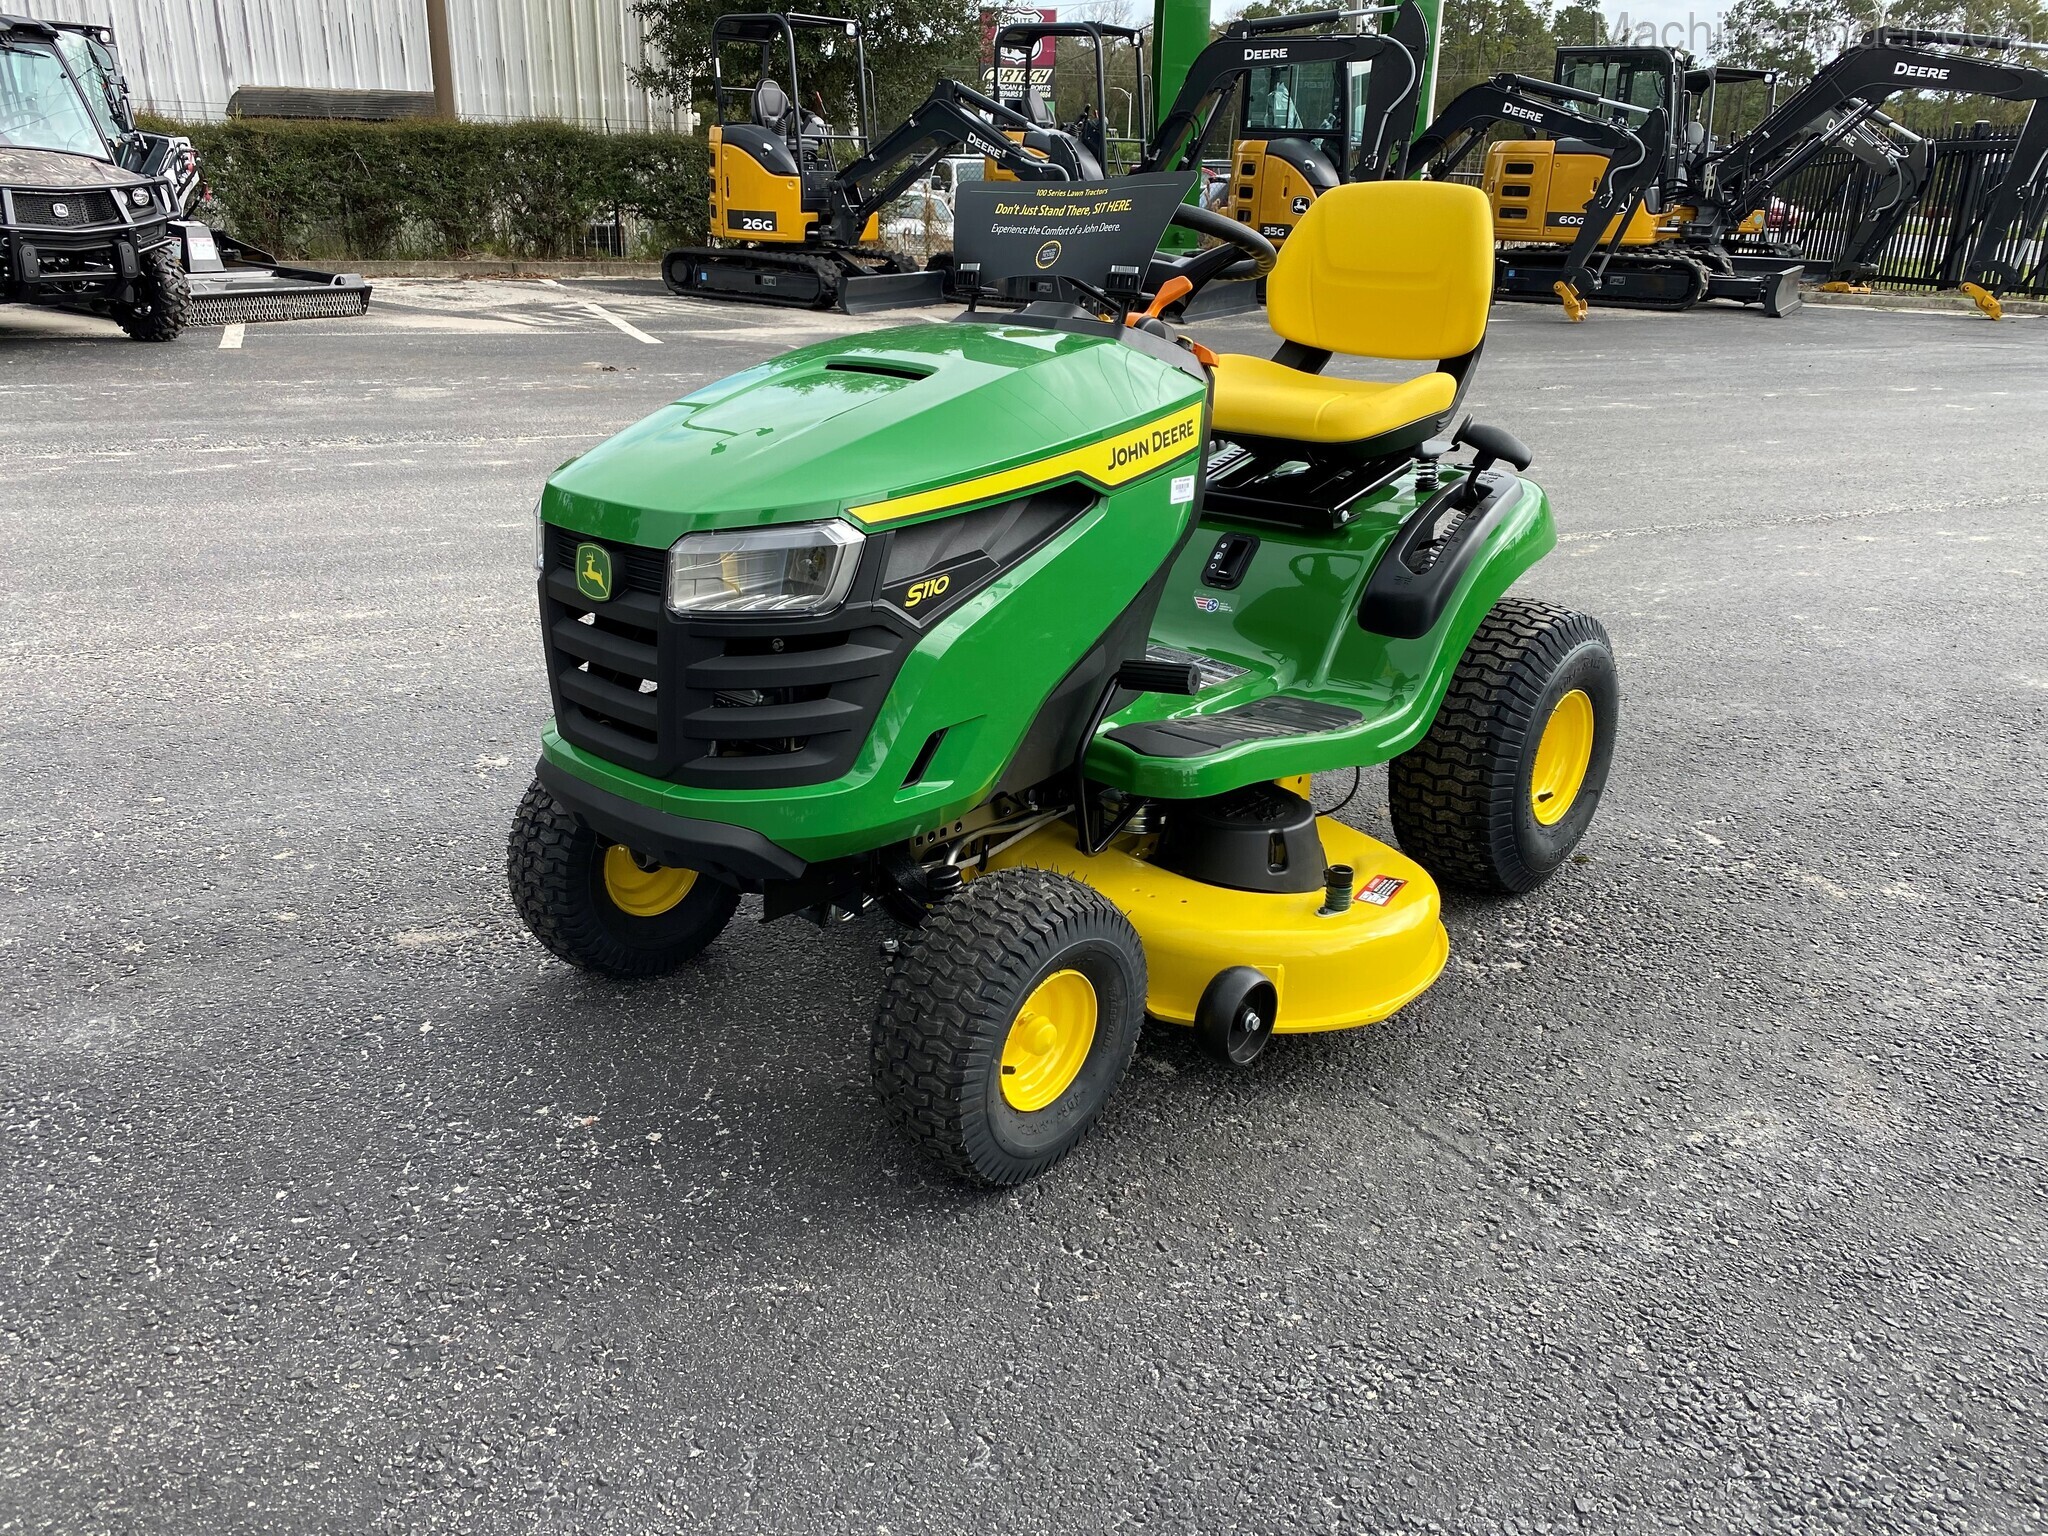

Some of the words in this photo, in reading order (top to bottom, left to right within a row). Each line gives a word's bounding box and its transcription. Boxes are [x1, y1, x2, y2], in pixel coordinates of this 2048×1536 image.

[1244, 48, 1288, 61] DEERE
[1893, 61, 1950, 81] DEERE
[1502, 102, 1544, 123] DEERE
[1825, 117, 1858, 148] DRE
[967, 131, 1002, 159] DEERE
[1036, 189, 1047, 197] 100
[1047, 189, 1067, 197] Series
[1067, 189, 1084, 197] Lawn
[1085, 188, 1109, 196] Tractors
[995, 203, 1020, 215] Don't
[1019, 203, 1039, 216] Just
[1038, 204, 1067, 217] Stand
[1066, 204, 1091, 217] There,
[1092, 202, 1108, 215] SIT
[1107, 199, 1133, 213] HERE.
[742, 217, 773, 232] 26G
[991, 223, 1029, 236] Experience
[1028, 224, 1041, 235] the
[1041, 225, 1070, 236] Comfort
[1069, 224, 1080, 235] of
[1082, 223, 1099, 234] John
[1099, 222, 1121, 232] Deere.
[1559, 216, 1584, 225] 60G
[1263, 226, 1285, 237] 35G
[1107, 438, 1150, 471] JOHN
[1152, 419, 1194, 453] DEERE
[904, 574, 951, 608] S110
